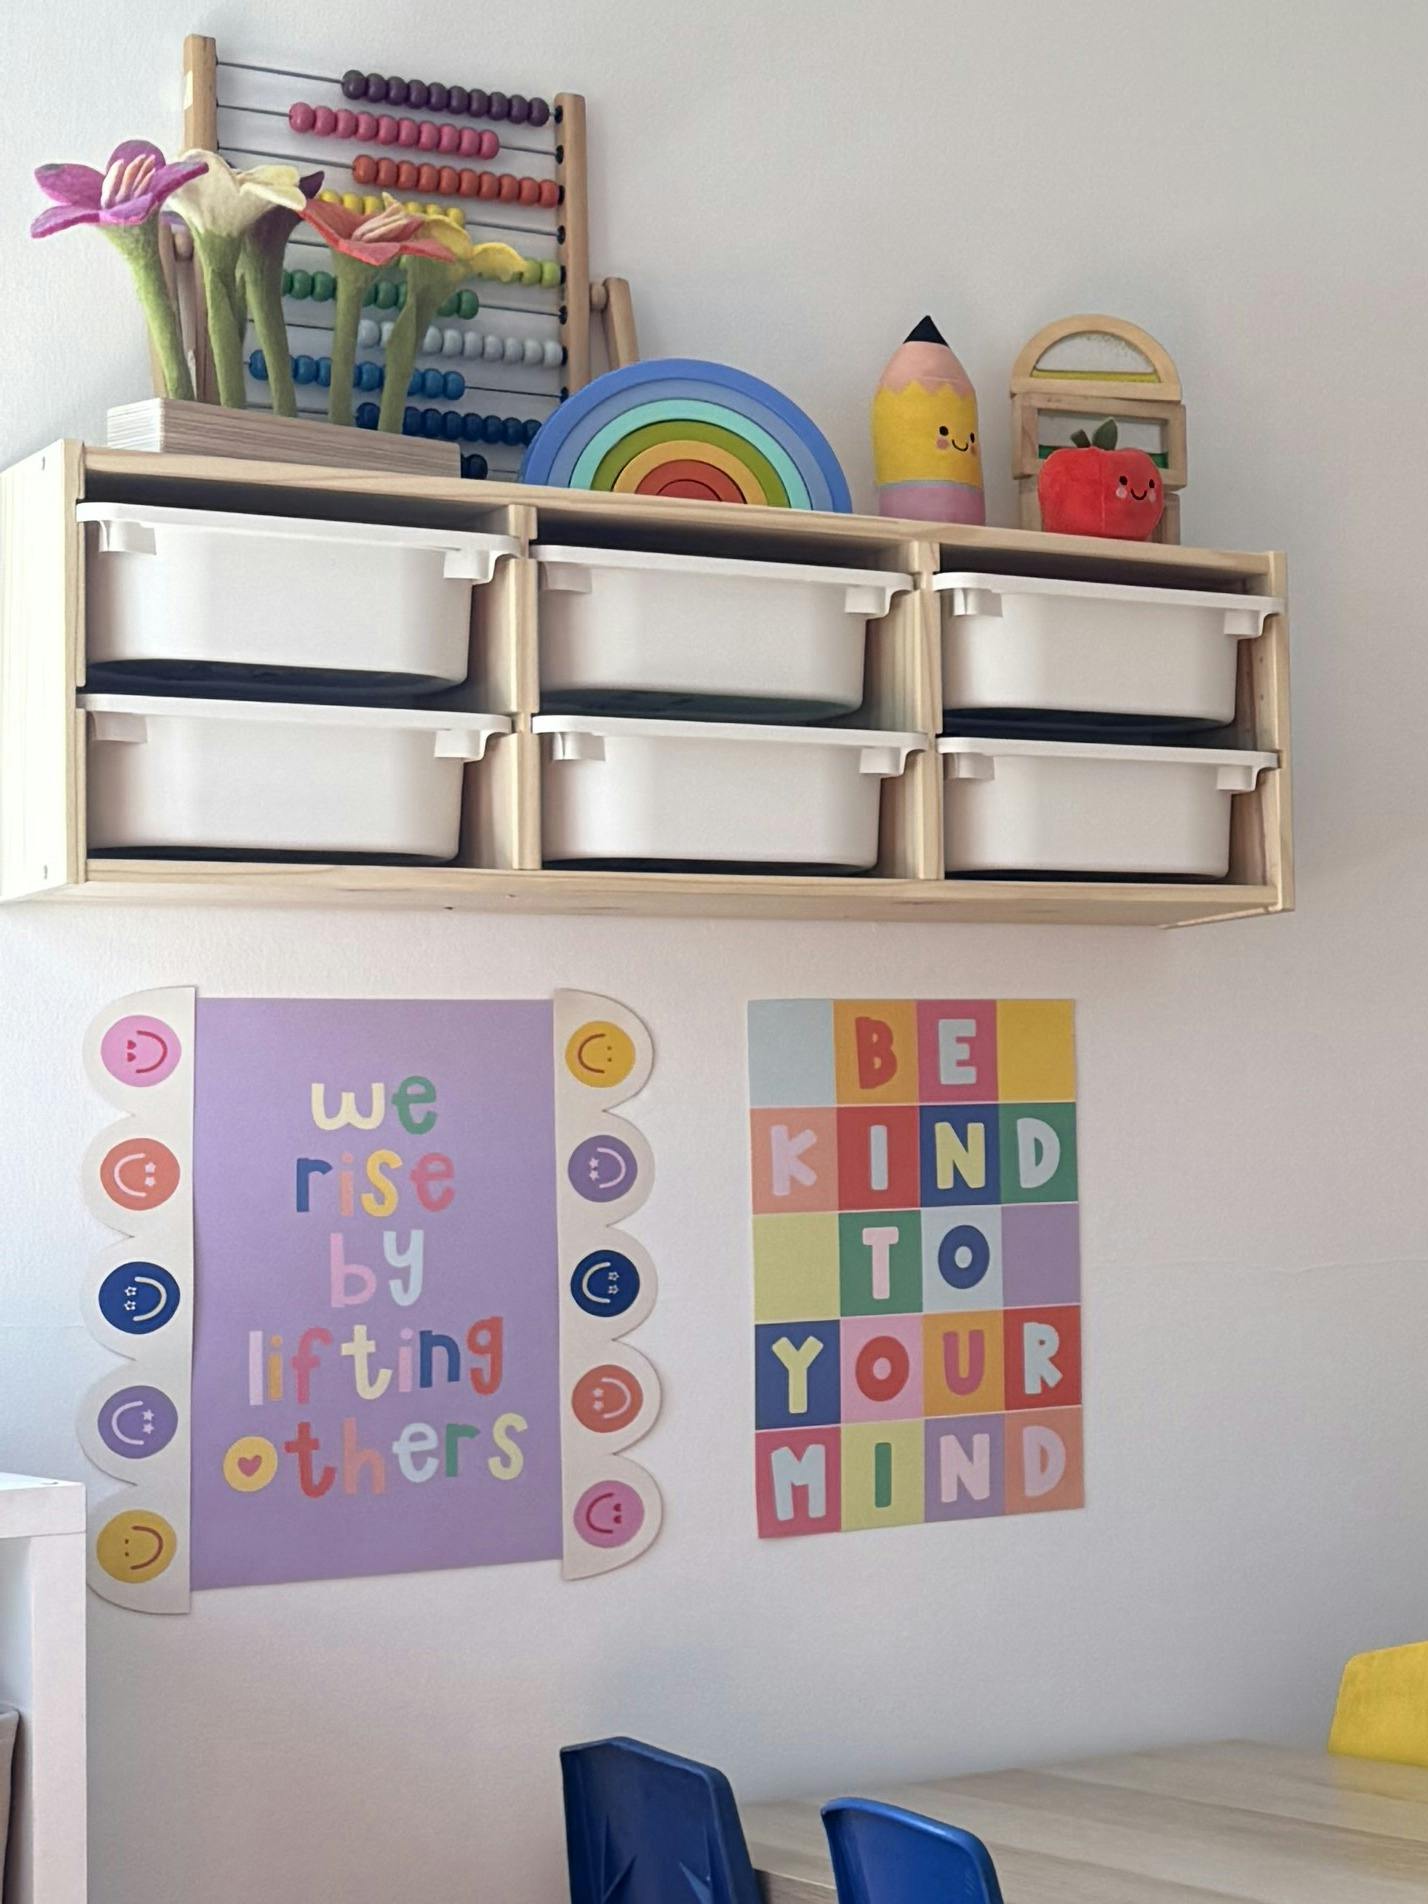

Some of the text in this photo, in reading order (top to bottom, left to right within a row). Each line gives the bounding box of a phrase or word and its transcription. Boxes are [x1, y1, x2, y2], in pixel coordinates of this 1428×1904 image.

[857, 1016, 979, 1091] BE
[312, 1076, 438, 1131] we
[296, 1151, 456, 1213] rise
[770, 1117, 1060, 1198] KIND
[330, 1229, 424, 1308] by
[861, 1224, 990, 1301] TO
[249, 1316, 503, 1405] lifting
[770, 1323, 1062, 1414] YOUR
[224, 1413, 527, 1499] others
[769, 1424, 1066, 1521] MIND
